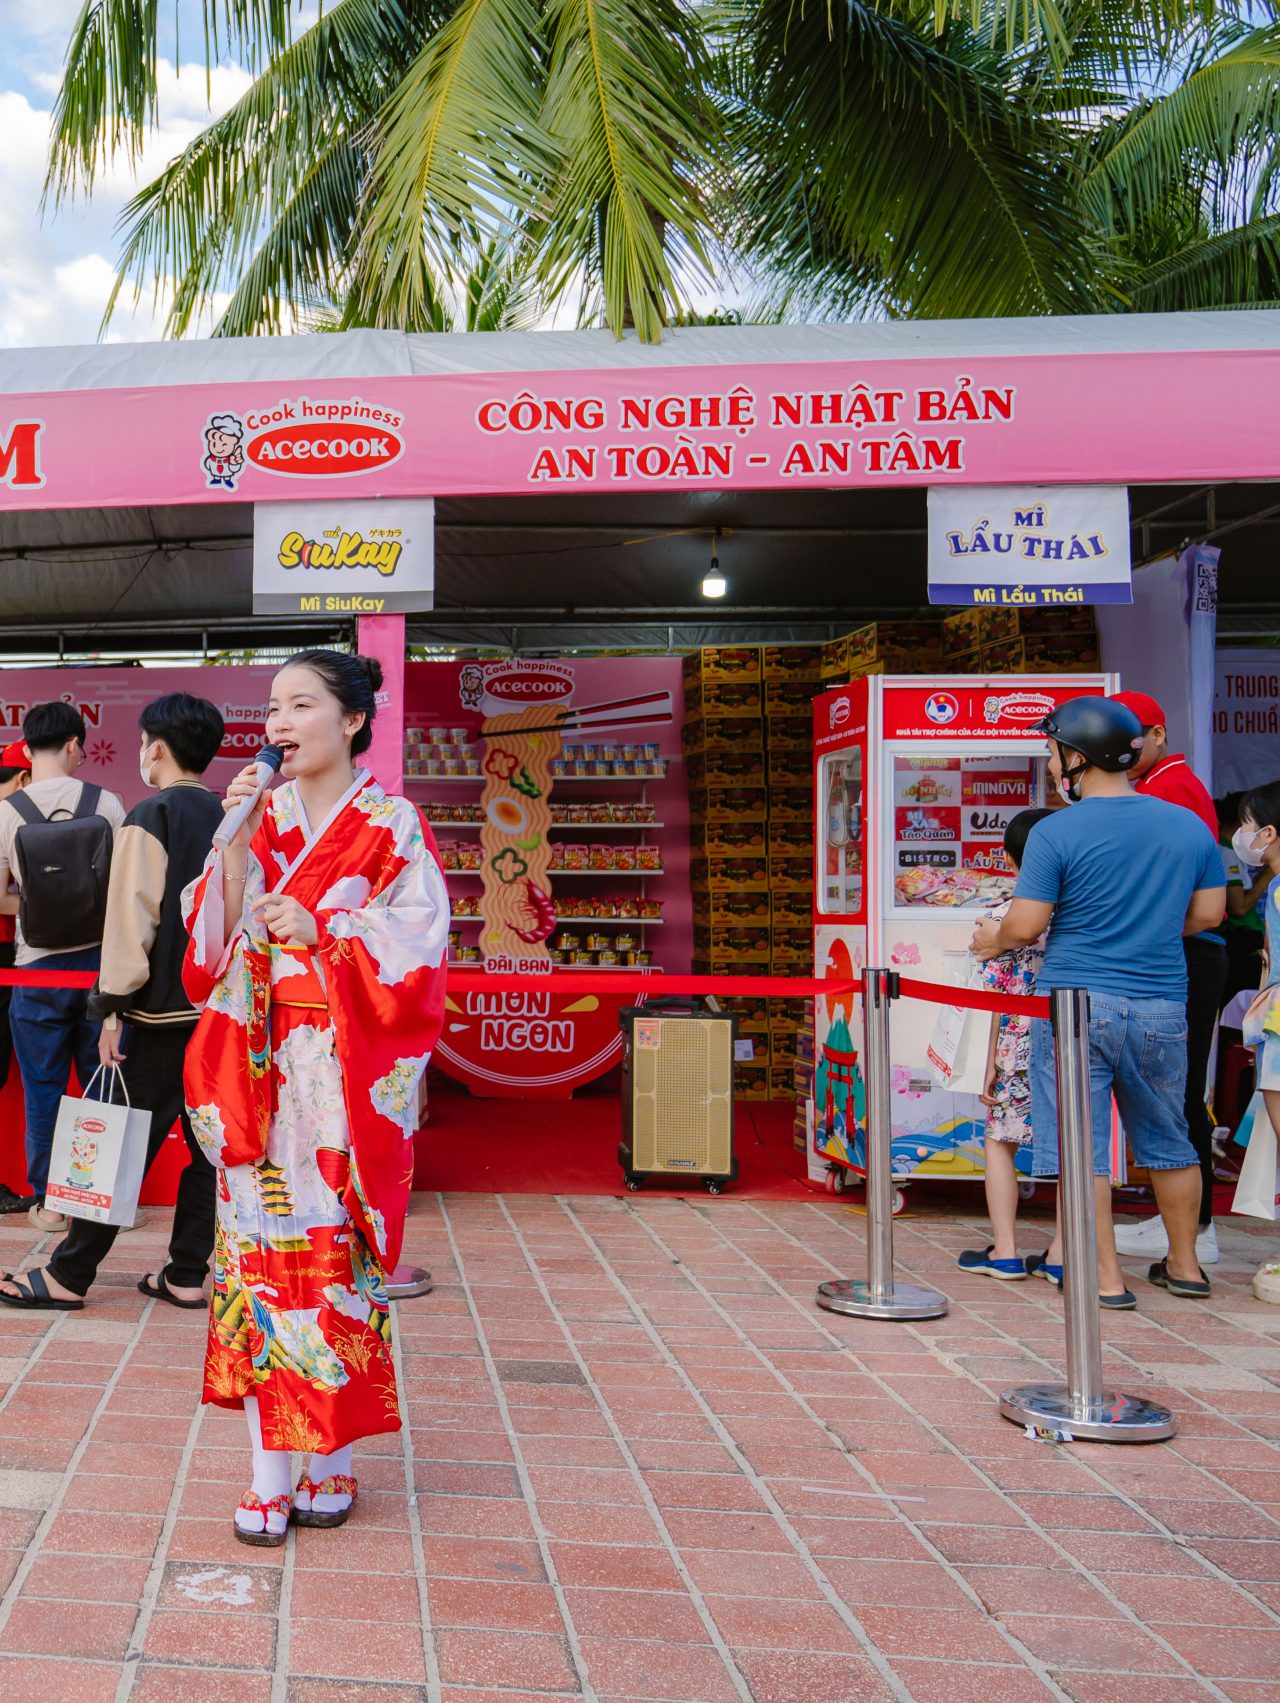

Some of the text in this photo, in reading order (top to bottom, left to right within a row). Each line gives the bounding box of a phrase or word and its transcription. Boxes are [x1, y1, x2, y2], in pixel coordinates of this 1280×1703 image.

[246, 400, 401, 430] Cook happiness
[477, 376, 1014, 436] CÔNG NGHỆ NHẬT BẢN
[530, 447, 596, 480] AN
[607, 435, 733, 478] TOÀN
[780, 441, 850, 474] AN
[861, 430, 963, 473] TÂM
[1013, 506, 1044, 527] MÌ
[369, 528, 402, 538] ゲキカラ
[949, 519, 1105, 560] LẨU THÁI
[973, 584, 1084, 603] Mì Lẩu Thái
[300, 595, 385, 613] Mì SiuKay
[484, 660, 573, 677] Cook happiness
[1224, 675, 1278, 698] TRUNG
[374, 691, 390, 703] ET
[226, 706, 266, 720] happi
[972, 782, 1026, 795] MINOVA
[970, 812, 1008, 830] Udo
[904, 854, 950, 863] BISTRO
[487, 954, 512, 971] ĐÃI
[480, 1018, 575, 1052] NGON
